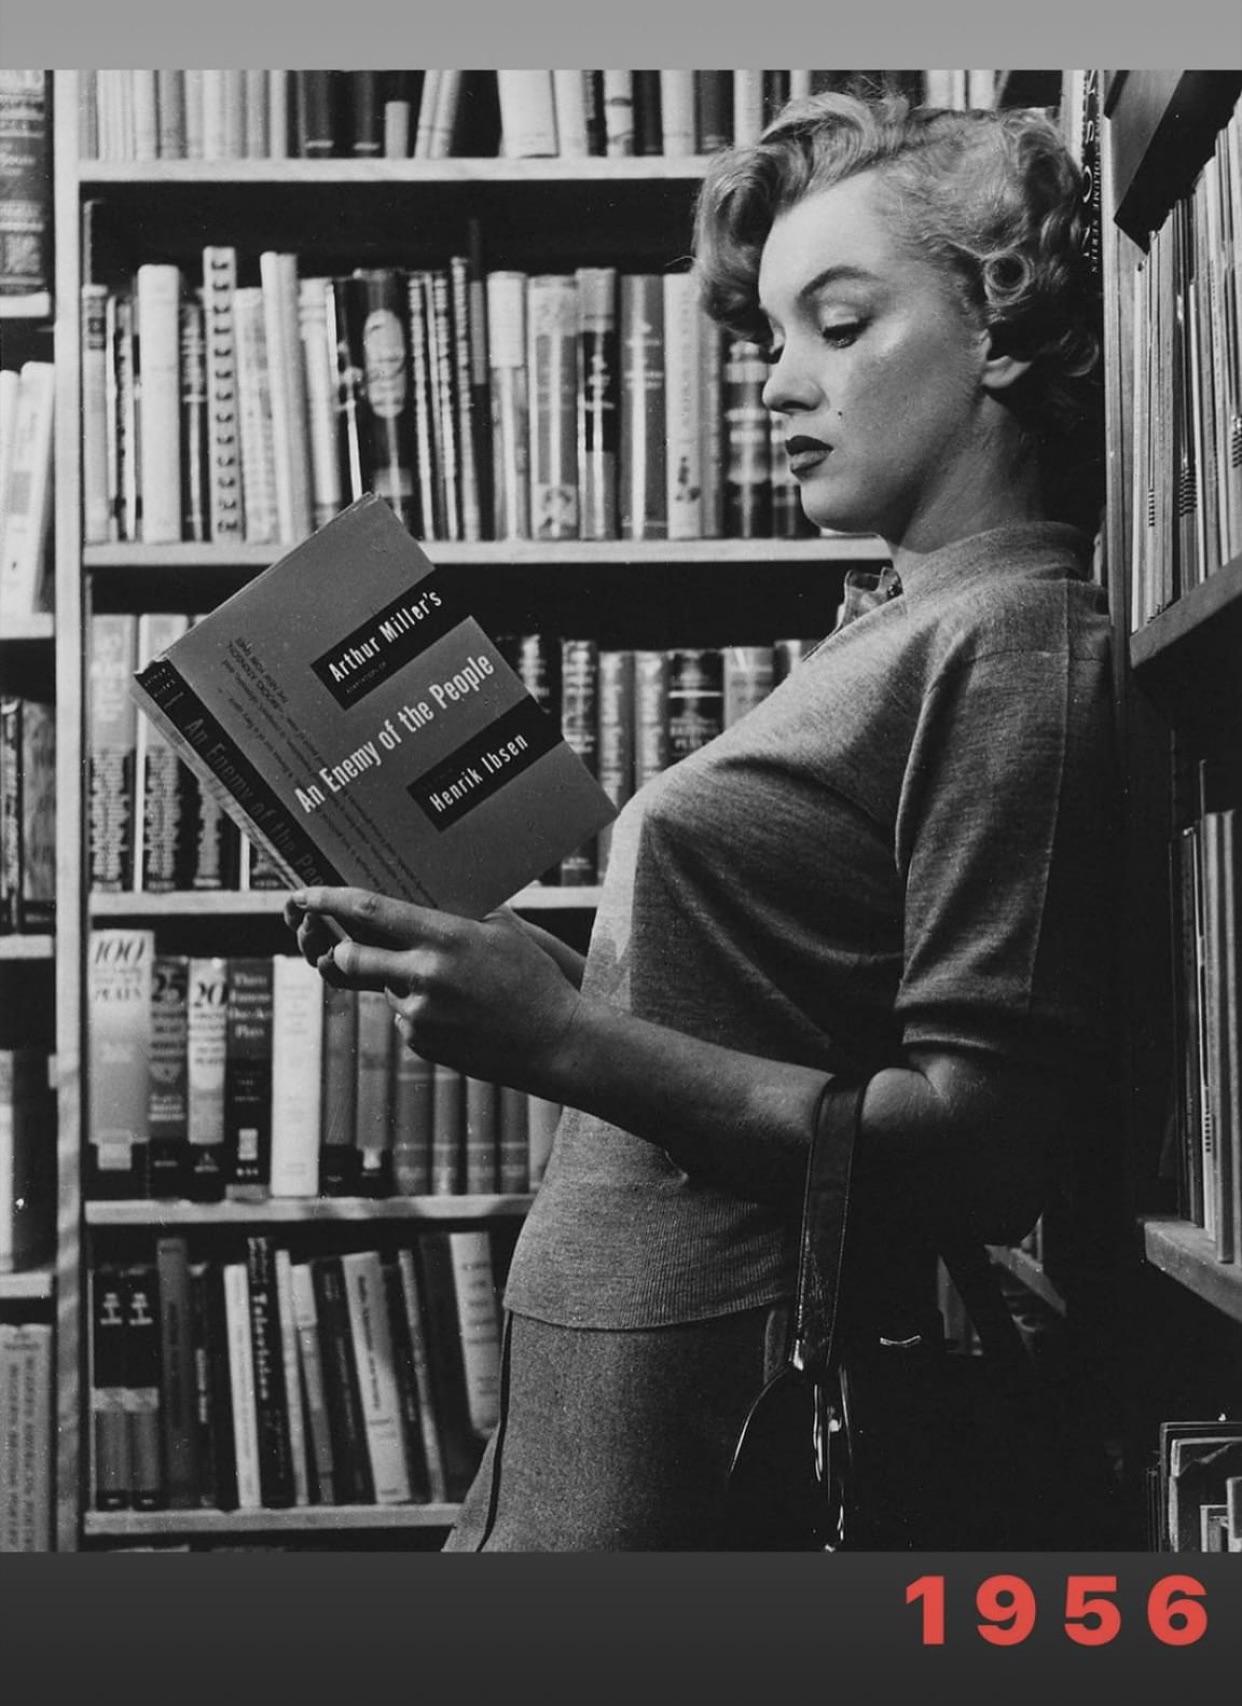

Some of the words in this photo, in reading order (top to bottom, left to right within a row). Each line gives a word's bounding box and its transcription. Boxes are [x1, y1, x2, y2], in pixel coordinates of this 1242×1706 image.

[329, 638, 379, 681] Arthur
[379, 593, 441, 642] Miller's
[295, 785, 325, 813] An
[319, 742, 381, 792] Enemy
[379, 720, 401, 749] of
[398, 702, 434, 732] the
[429, 656, 493, 709] People
[430, 768, 482, 811] Henrik
[482, 736, 527, 773] Ibsen
[182, 716, 212, 746] An
[208, 744, 257, 801] Enemy
[252, 799, 274, 822] of
[270, 822, 298, 852] the
[295, 853, 325, 888] Peo
